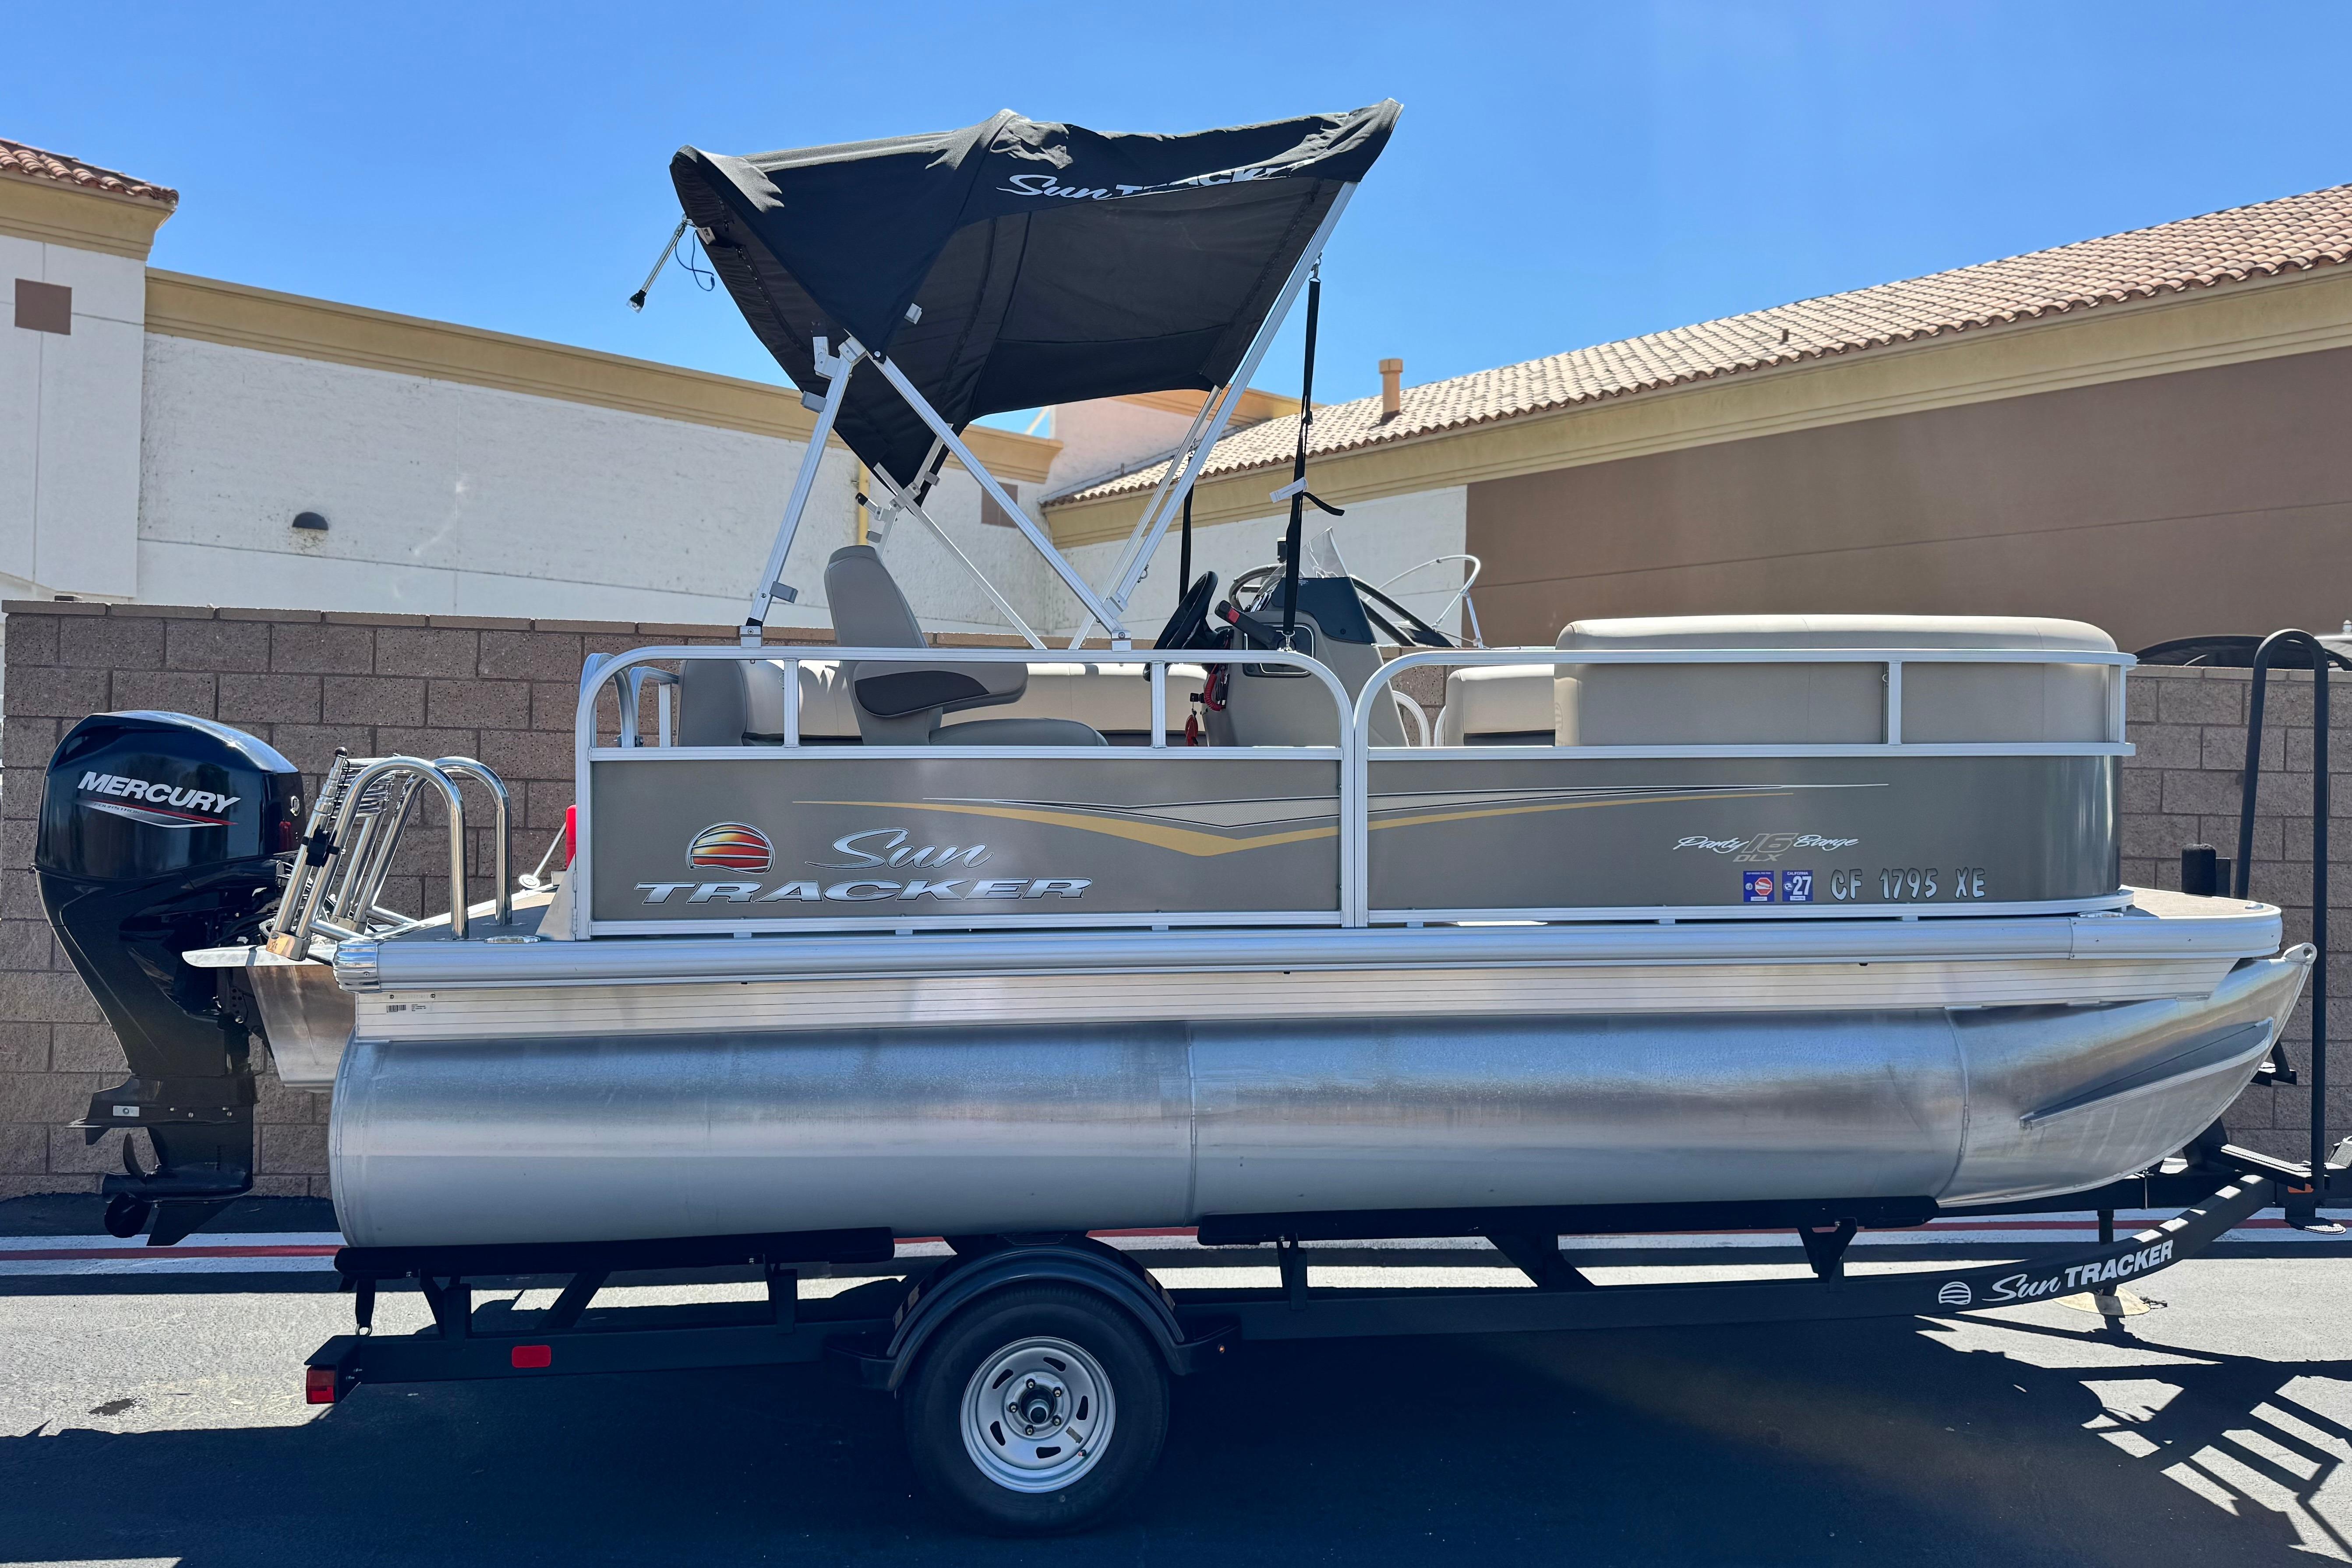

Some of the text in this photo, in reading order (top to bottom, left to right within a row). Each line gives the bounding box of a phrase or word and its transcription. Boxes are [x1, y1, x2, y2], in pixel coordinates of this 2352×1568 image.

[996, 174, 1113, 200] Sun
[78, 771, 241, 813] MERCURY
[805, 827, 995, 869] Sun
[1673, 833, 1860, 854] Party 16 Barge
[1732, 854, 1783, 862] DLX
[634, 877, 1093, 905] TRACKER
[1792, 876, 1812, 895] 27
[1830, 867, 1986, 900] CF 1795 XE
[1981, 1240, 2173, 1302] Sun TRACKER
